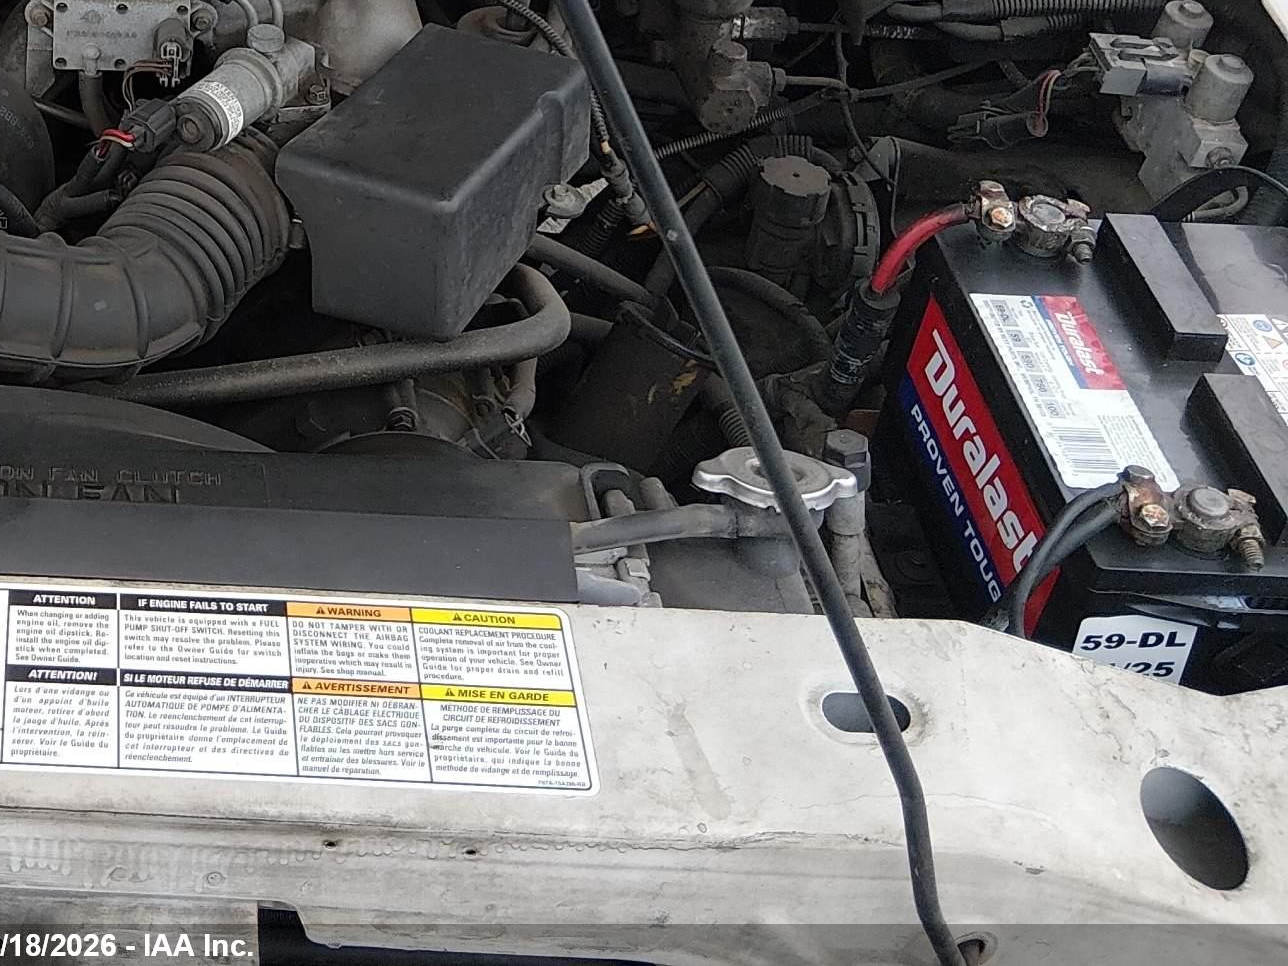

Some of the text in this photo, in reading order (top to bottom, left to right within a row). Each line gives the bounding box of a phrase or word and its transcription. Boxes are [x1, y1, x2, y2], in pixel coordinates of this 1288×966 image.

[1055, 311, 1104, 375] Duralast
[924, 328, 1037, 574] Duralast
[117, 469, 221, 485] CLUTCH
[911, 404, 1002, 603] PROVEN TOUG
[34, 594, 95, 605] ATTENTION
[138, 598, 268, 612] IF ENGINE FAILS TO START
[40, 611, 73, 620] changing
[84, 613, 109, 621] adding
[327, 607, 381, 617] WARNING
[464, 614, 515, 624] CAUTION
[124, 623, 147, 631] PUMP
[151, 624, 187, 633] SHUT-OFF
[330, 622, 364, 630] TAMPER
[293, 629, 408, 642] DISCONNECT THE AIRBAG
[418, 627, 555, 640] COOLANT REPLACEMENT PROCEDURE
[293, 638, 327, 646] SYSTEM
[1080, 631, 1187, 651] 59-DL
[29, 669, 96, 680] ATTENTION!
[124, 673, 133, 682] SI
[134, 674, 145, 682] LE
[147, 674, 185, 684] MOTEUR
[187, 676, 221, 686] REFUSE
[223, 678, 236, 686] DE
[315, 682, 409, 694] AVERTISSEMENT
[458, 689, 548, 701] MISE EN GARDE
